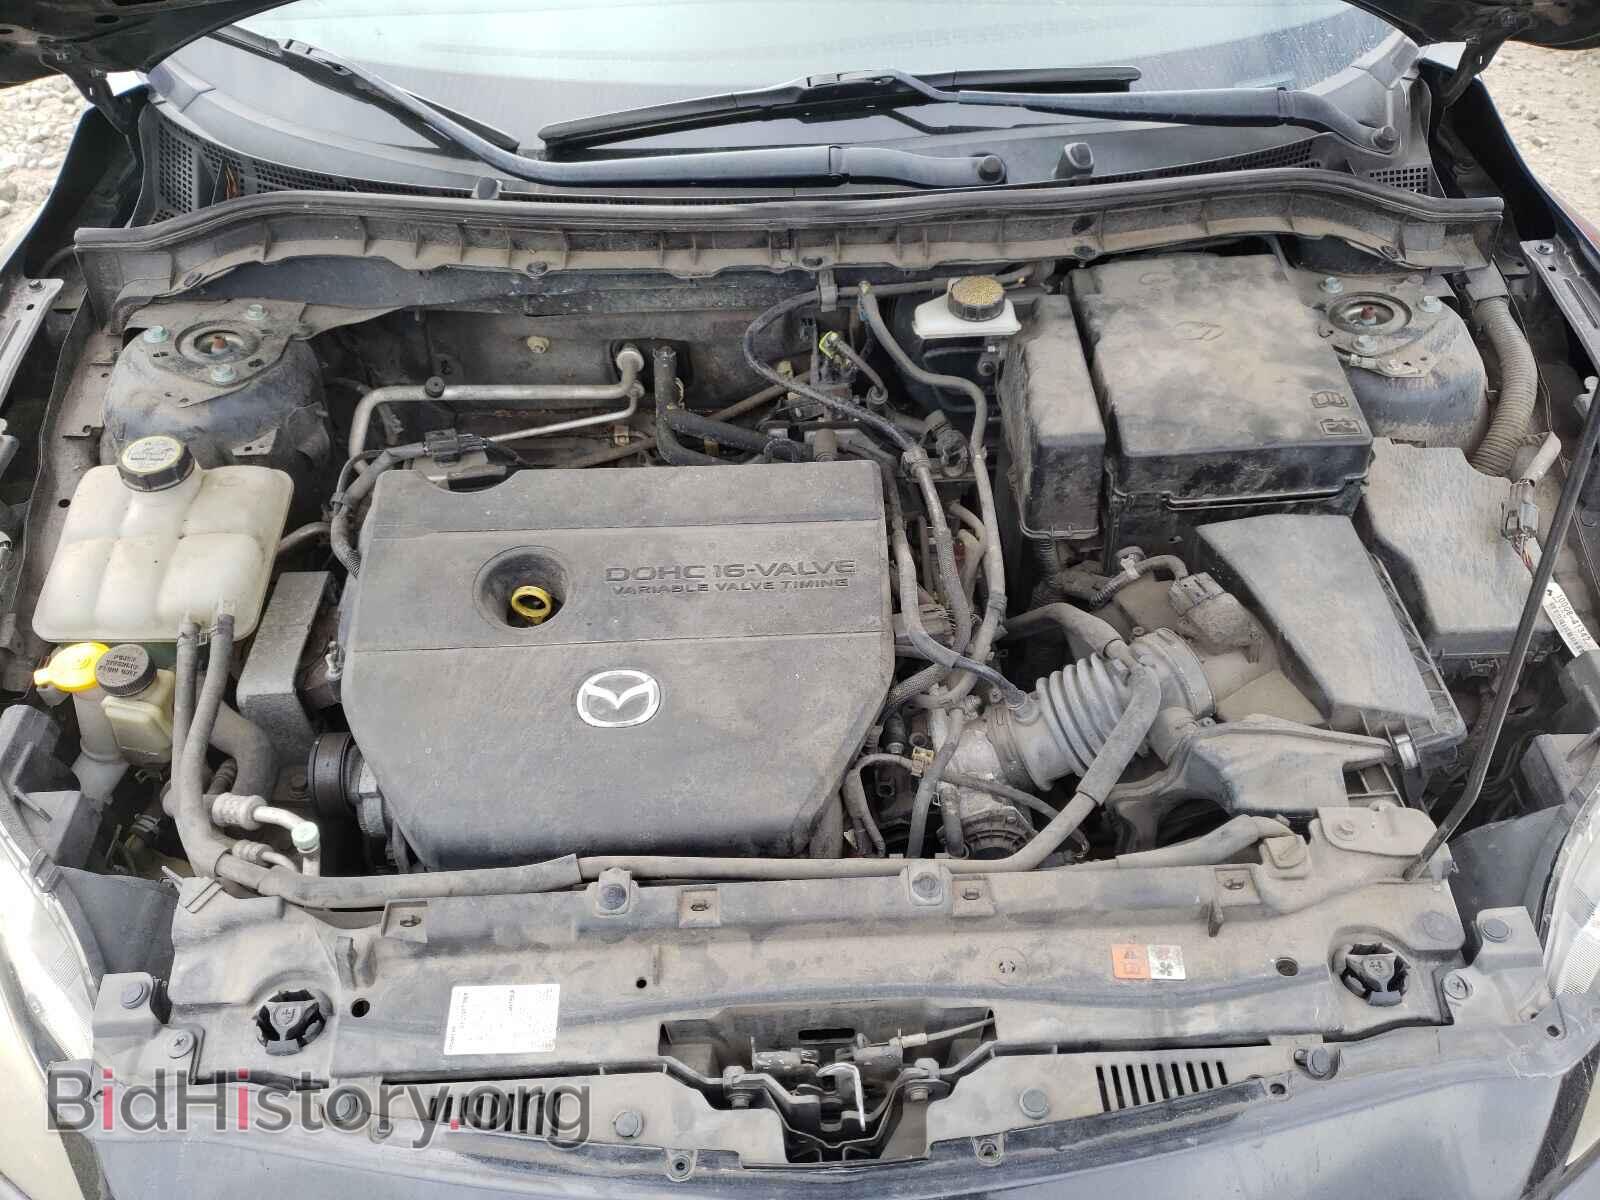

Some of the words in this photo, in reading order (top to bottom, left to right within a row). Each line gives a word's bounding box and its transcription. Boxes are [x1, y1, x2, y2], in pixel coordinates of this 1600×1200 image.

[605, 565, 706, 581] DOHC
[713, 560, 856, 578] 16-VALVE
[612, 583, 709, 595] VARIABLE
[715, 581, 775, 592] VALVE
[780, 578, 849, 590] TIMING
